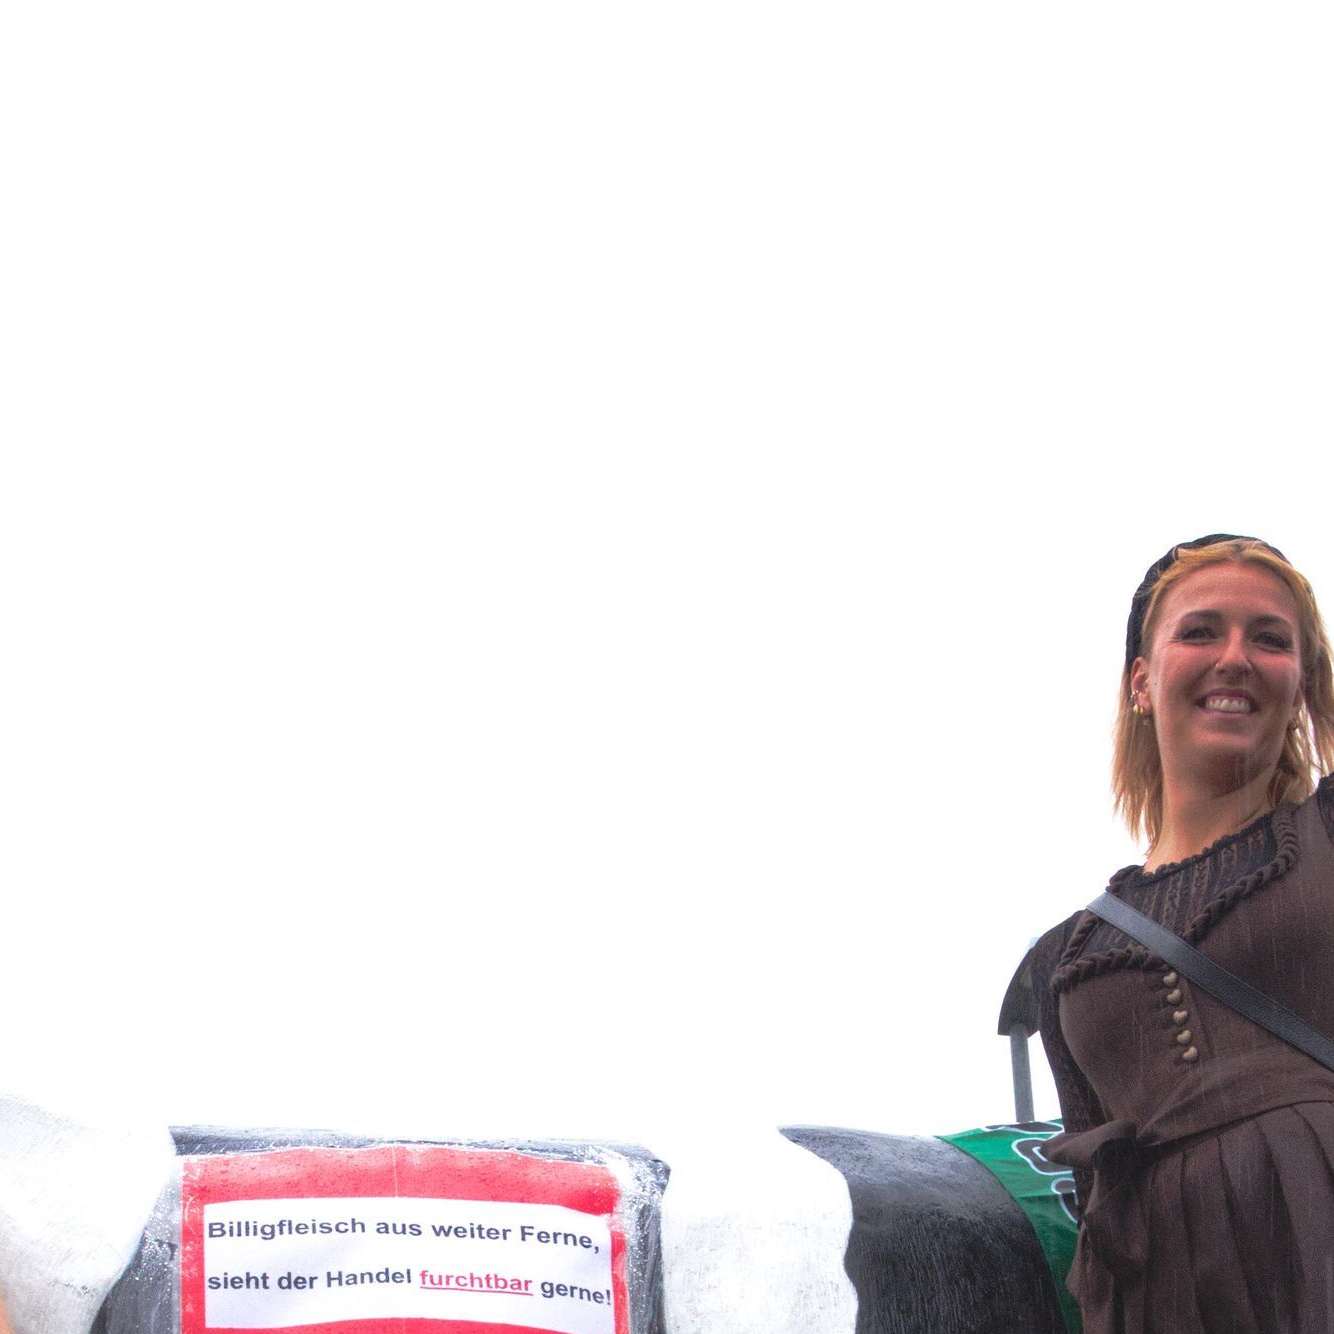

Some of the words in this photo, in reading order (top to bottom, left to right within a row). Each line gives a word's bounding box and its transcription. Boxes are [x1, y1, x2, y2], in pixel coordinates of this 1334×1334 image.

[207, 1217, 366, 1241] Billigfleisch
[375, 1221, 423, 1237] aus
[431, 1222, 512, 1241] weiter
[519, 1225, 600, 1254] Ferne,
[207, 1271, 270, 1290] sieht
[277, 1271, 318, 1290] der
[326, 1267, 413, 1288] Handel
[419, 1269, 534, 1294] furchtbar
[540, 1280, 612, 1306] gerne!
